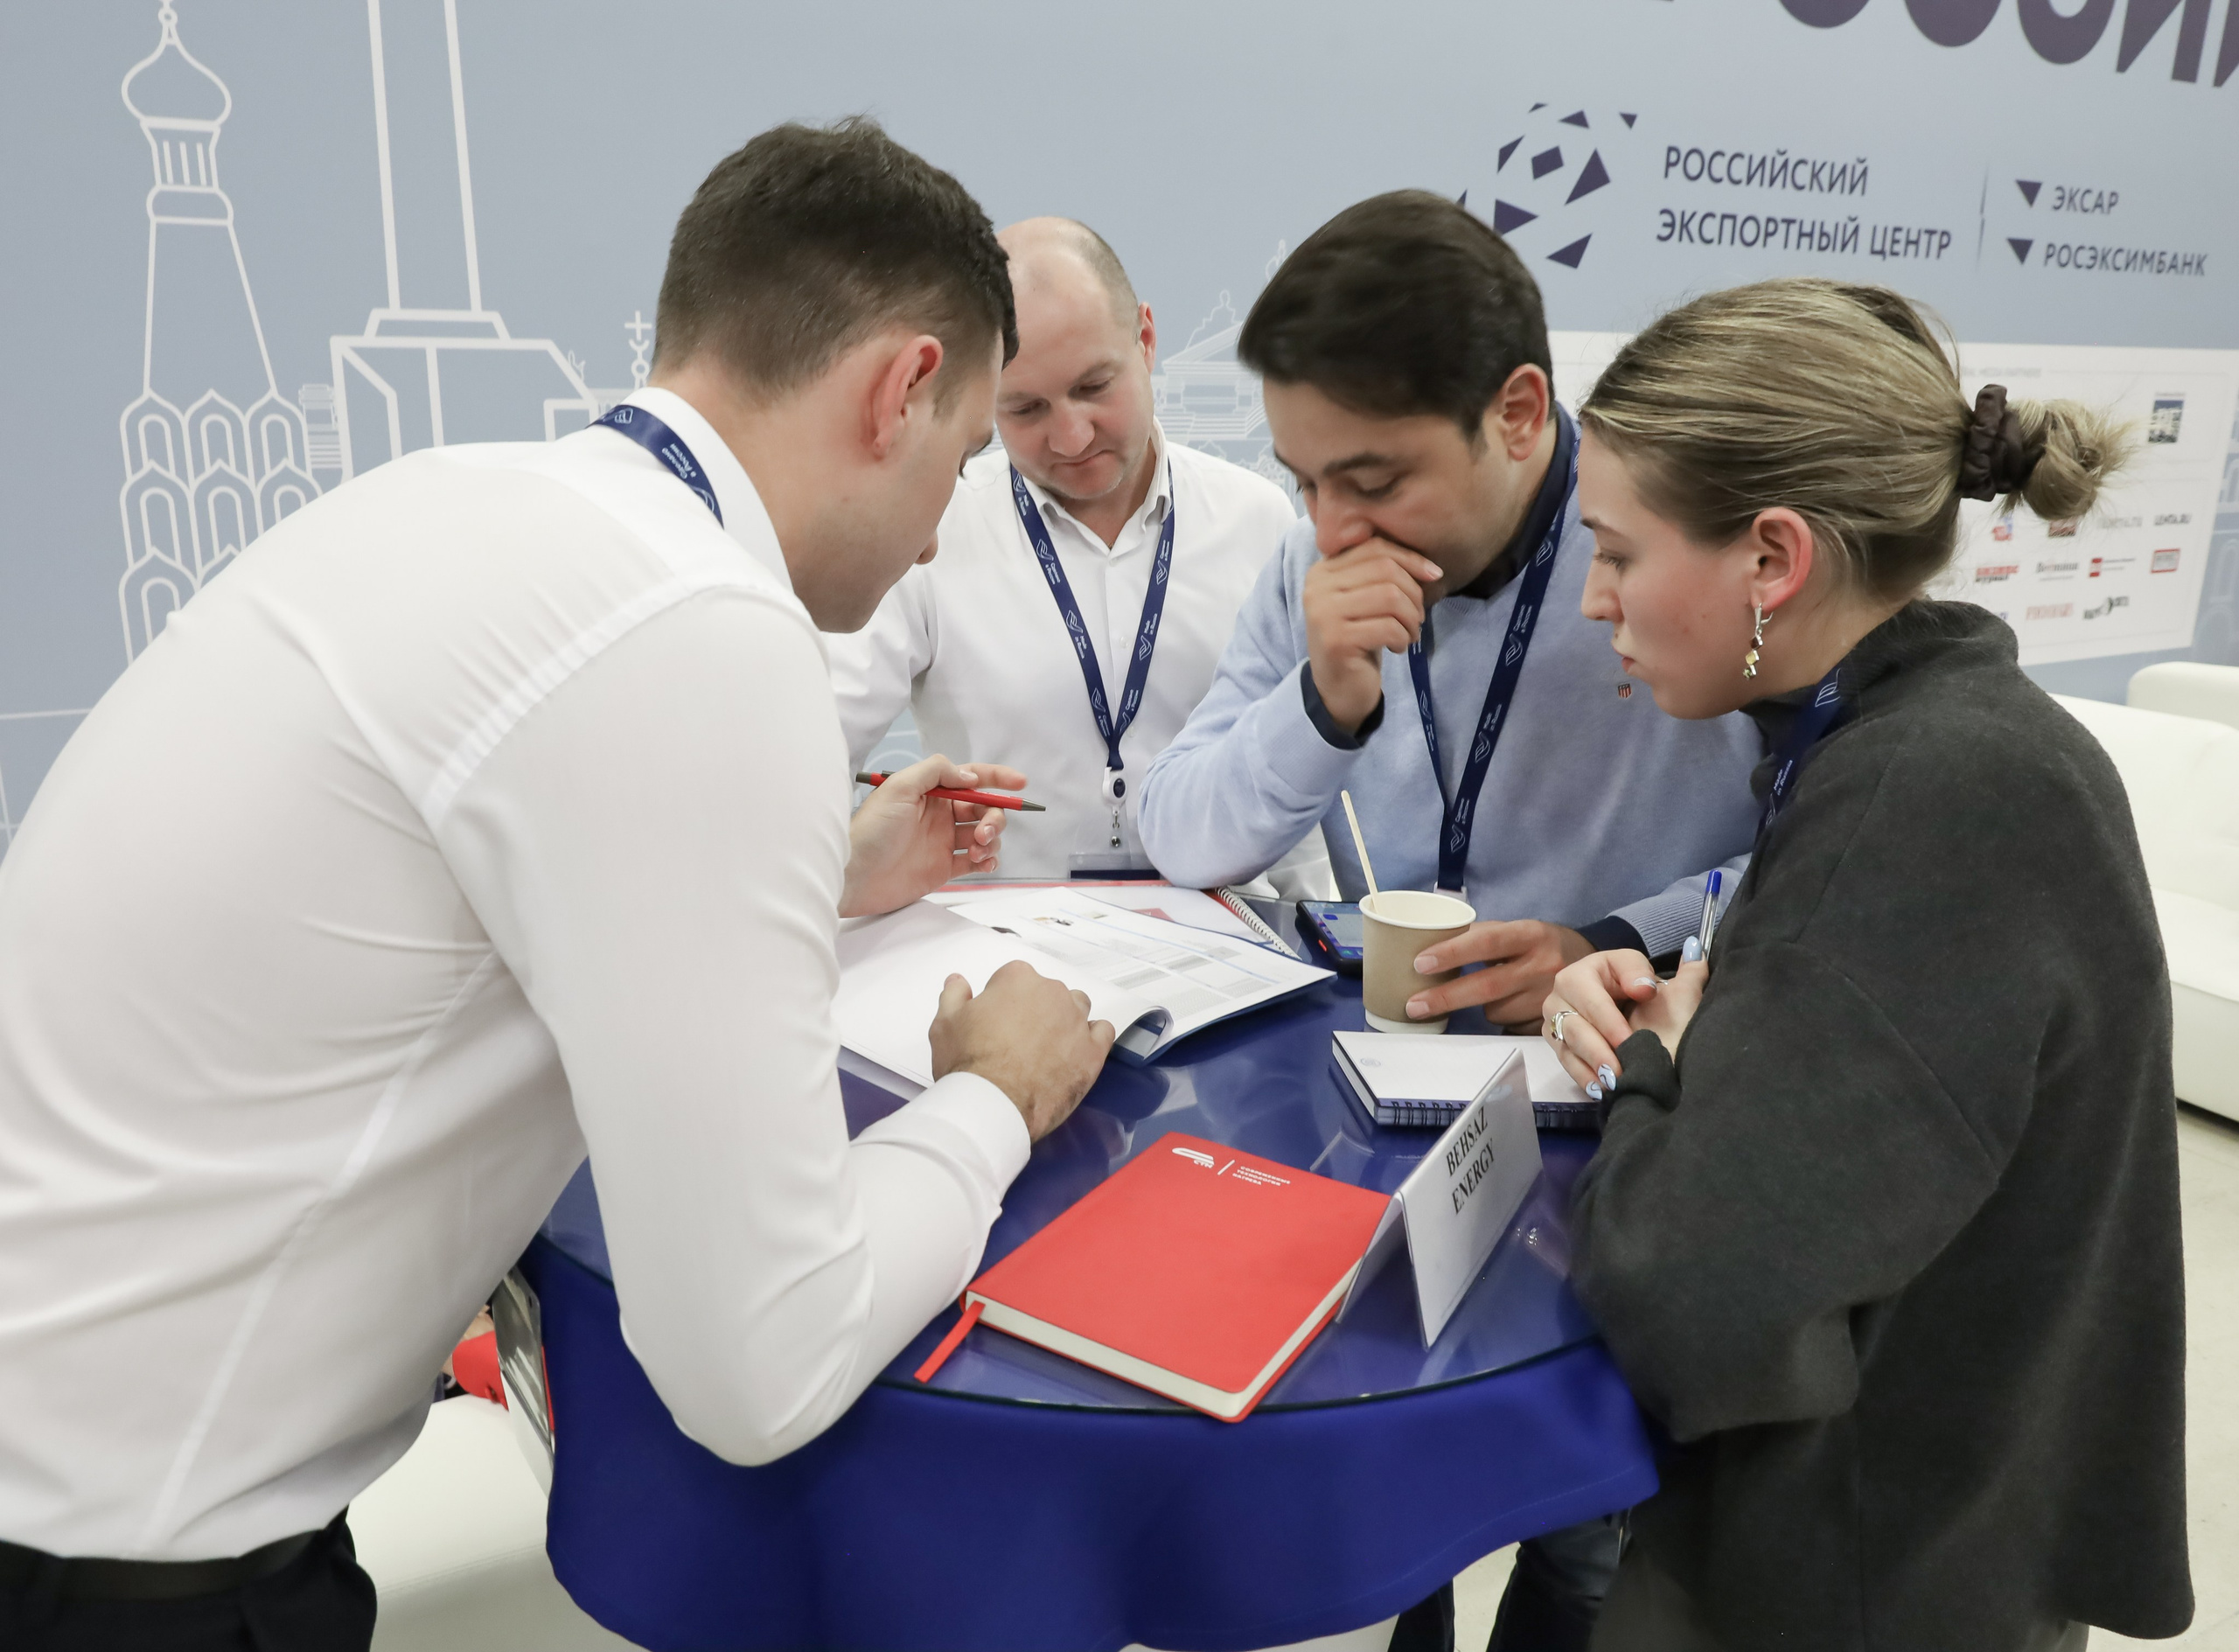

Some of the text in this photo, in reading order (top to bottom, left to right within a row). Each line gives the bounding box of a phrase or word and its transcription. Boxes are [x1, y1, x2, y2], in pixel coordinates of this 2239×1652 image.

[1664, 145, 1868, 197] РОССИЙСКИЙ
[2052, 185, 2119, 214] ЭКСАР
[1656, 208, 1952, 261] ЭКСПОРТНЫЙ ЦЕНТР
[2043, 242, 2208, 277] РОСЭКСИМБАНК
[1446, 1105, 1489, 1177] BEHSAZ
[1451, 1137, 1495, 1216] ENERGY
